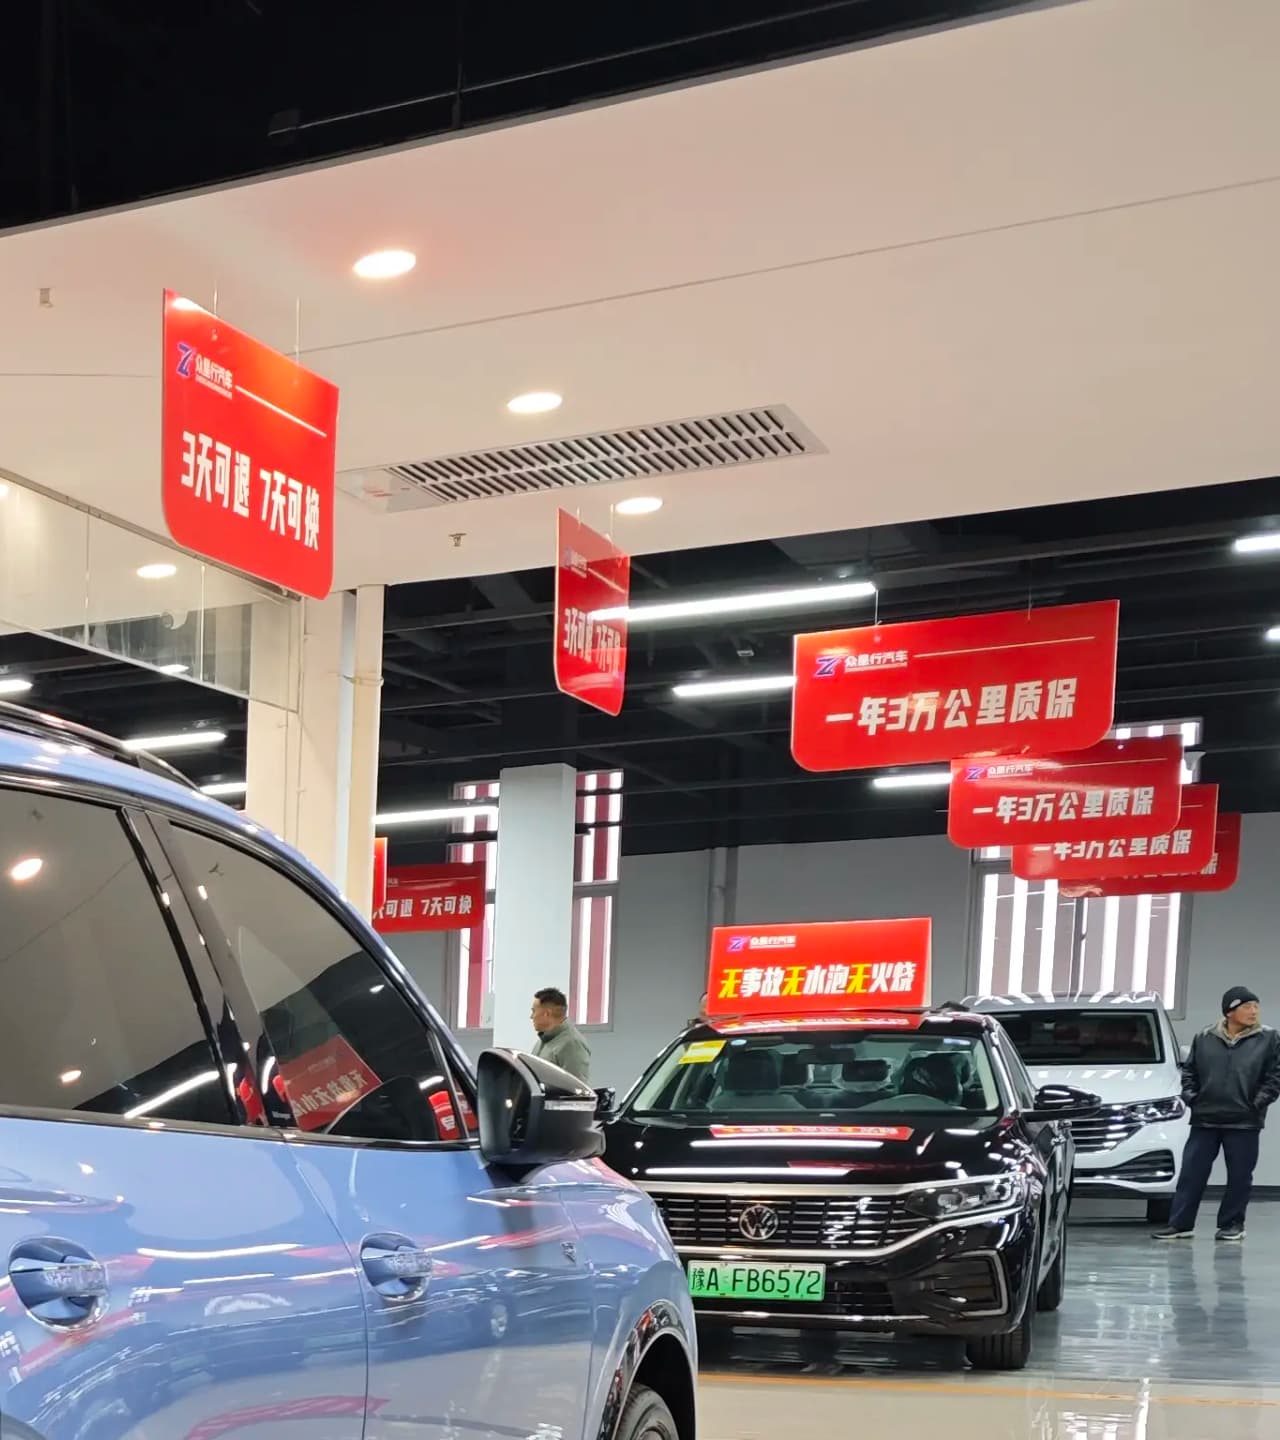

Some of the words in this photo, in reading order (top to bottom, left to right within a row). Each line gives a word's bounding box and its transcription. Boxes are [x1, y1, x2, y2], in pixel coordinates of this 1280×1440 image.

[180, 430, 251, 519] 3天可退
[258, 468, 321, 551] 7天可换
[825, 677, 1078, 736] 一年3万公里质保
[972, 785, 1156, 824] 一年3万公里质保
[420, 894, 473, 917] 7天可换
[717, 961, 917, 999] 无事故无水泡无火烧
